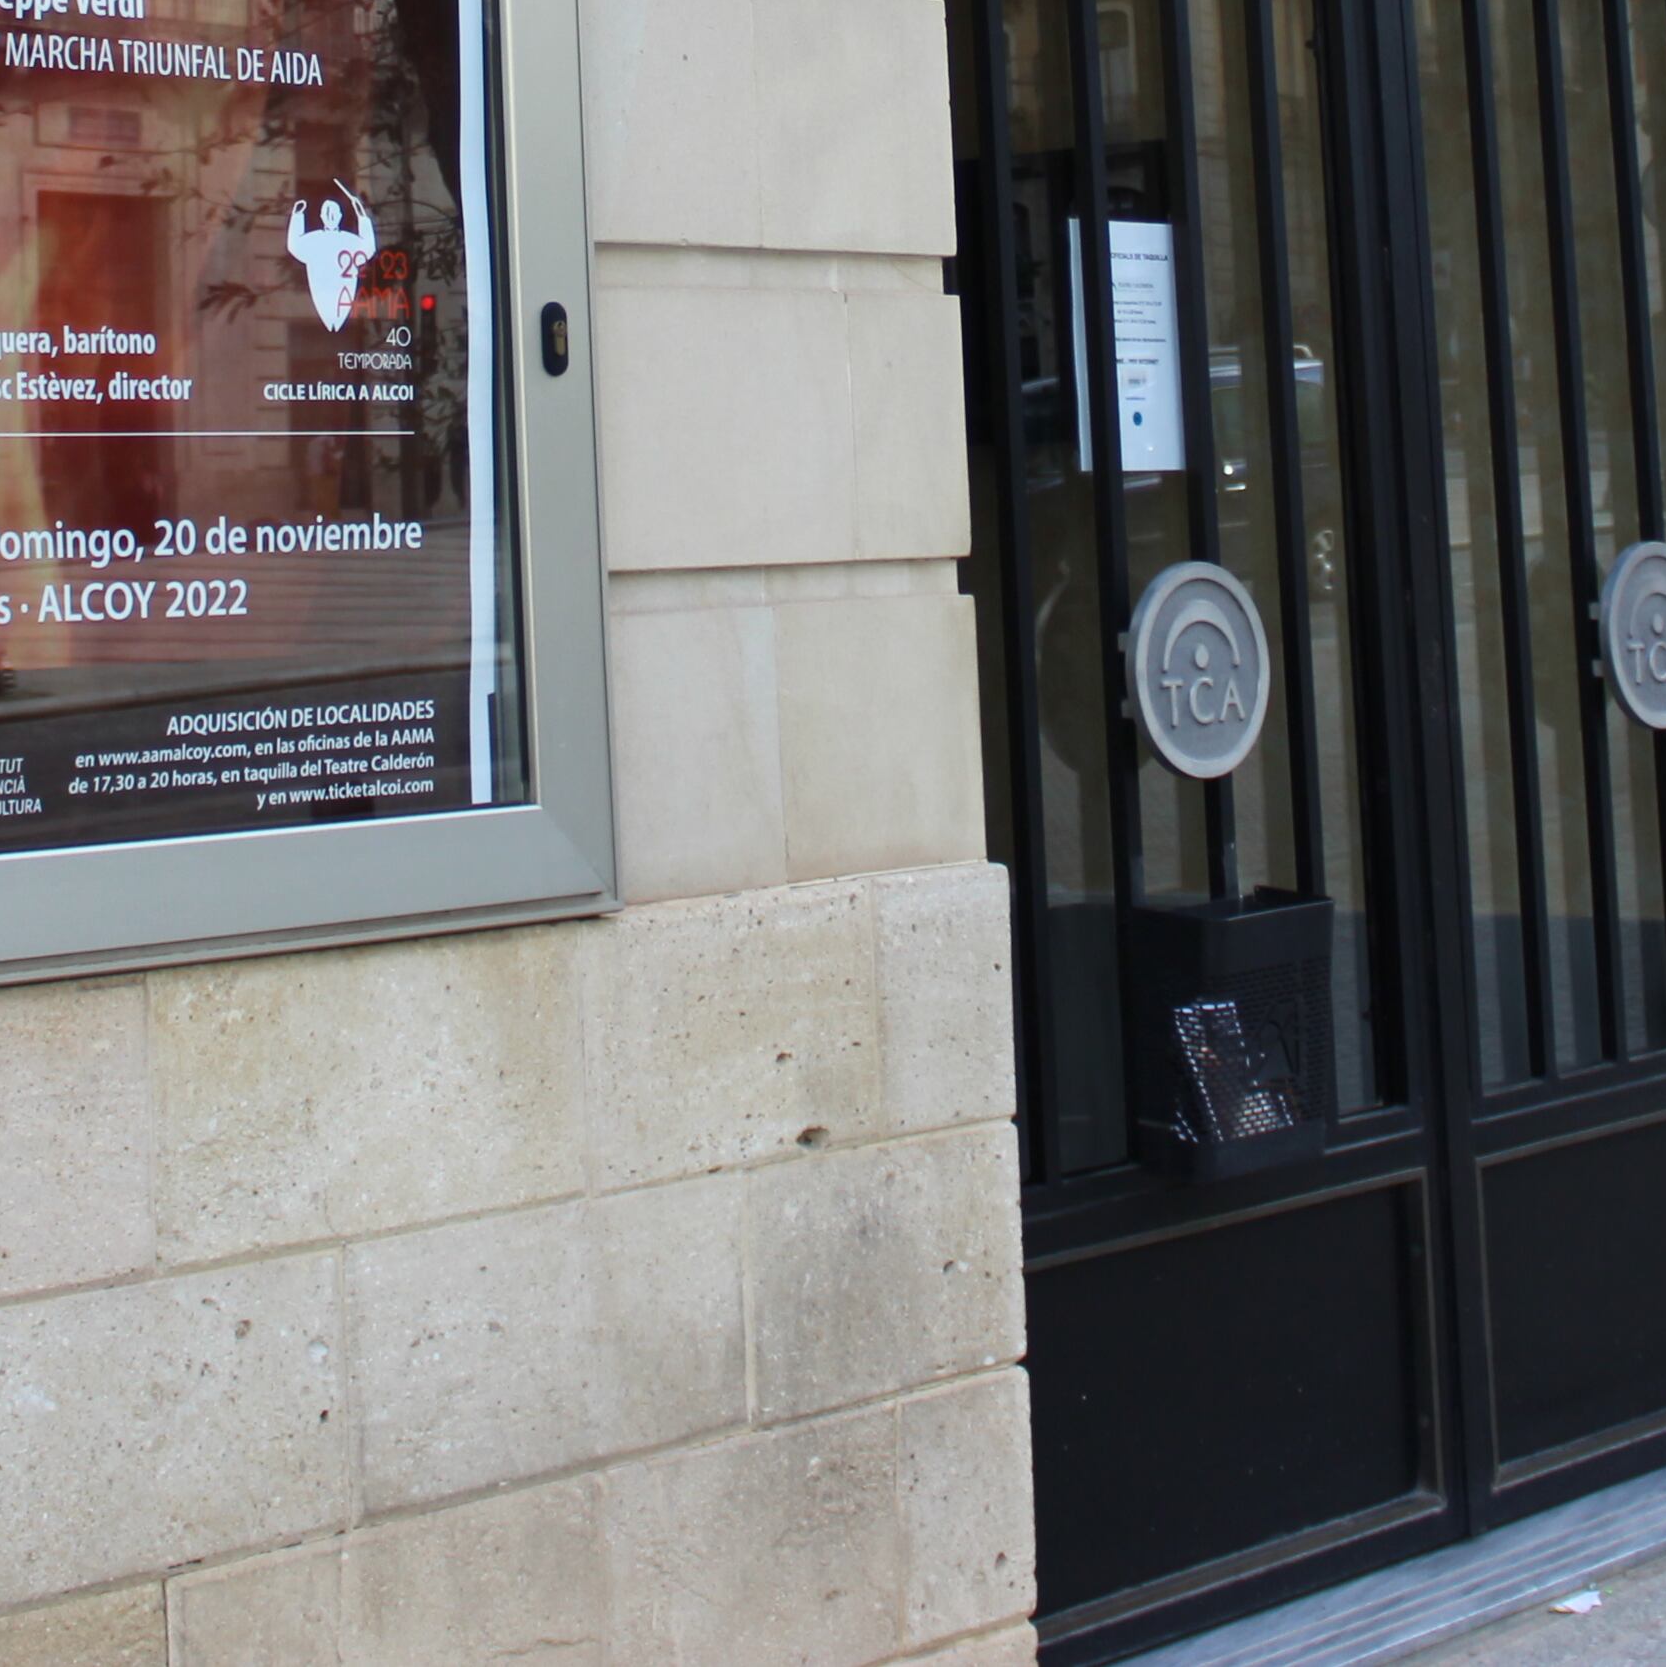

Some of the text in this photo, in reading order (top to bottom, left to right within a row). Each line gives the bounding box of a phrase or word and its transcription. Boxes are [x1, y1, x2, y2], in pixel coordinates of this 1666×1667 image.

[4, 31, 116, 73] MARCHA
[123, 37, 230, 80] TRIUNFAL
[236, 47, 264, 83] DE
[270, 50, 322, 86] AIDA
[64, 324, 156, 355] barítono
[386, 327, 411, 347] 40
[338, 352, 412, 370] TEMPORADA
[16, 371, 103, 405] Estèvez,
[108, 371, 192, 401] director
[263, 380, 414, 402] CICLE LÍRICA A ALCOI
[153, 518, 196, 557] 20
[205, 516, 247, 556] de
[255, 512, 423, 554] noviembre
[38, 579, 157, 623] ALCOY
[165, 579, 248, 619] 2022
[167, 699, 435, 736] ADQUISICIÓN DE LOCALIDADES
[1161, 677, 1246, 728] TCA
[75, 727, 434, 769] en www.aamalcoy.com, en las oficinas de la AAMA
[68, 752, 434, 795] de 17,30 a 20 horas, en taquilla del Teatre Calderón
[257, 777, 434, 810] y en www.ticketalcoi.com
